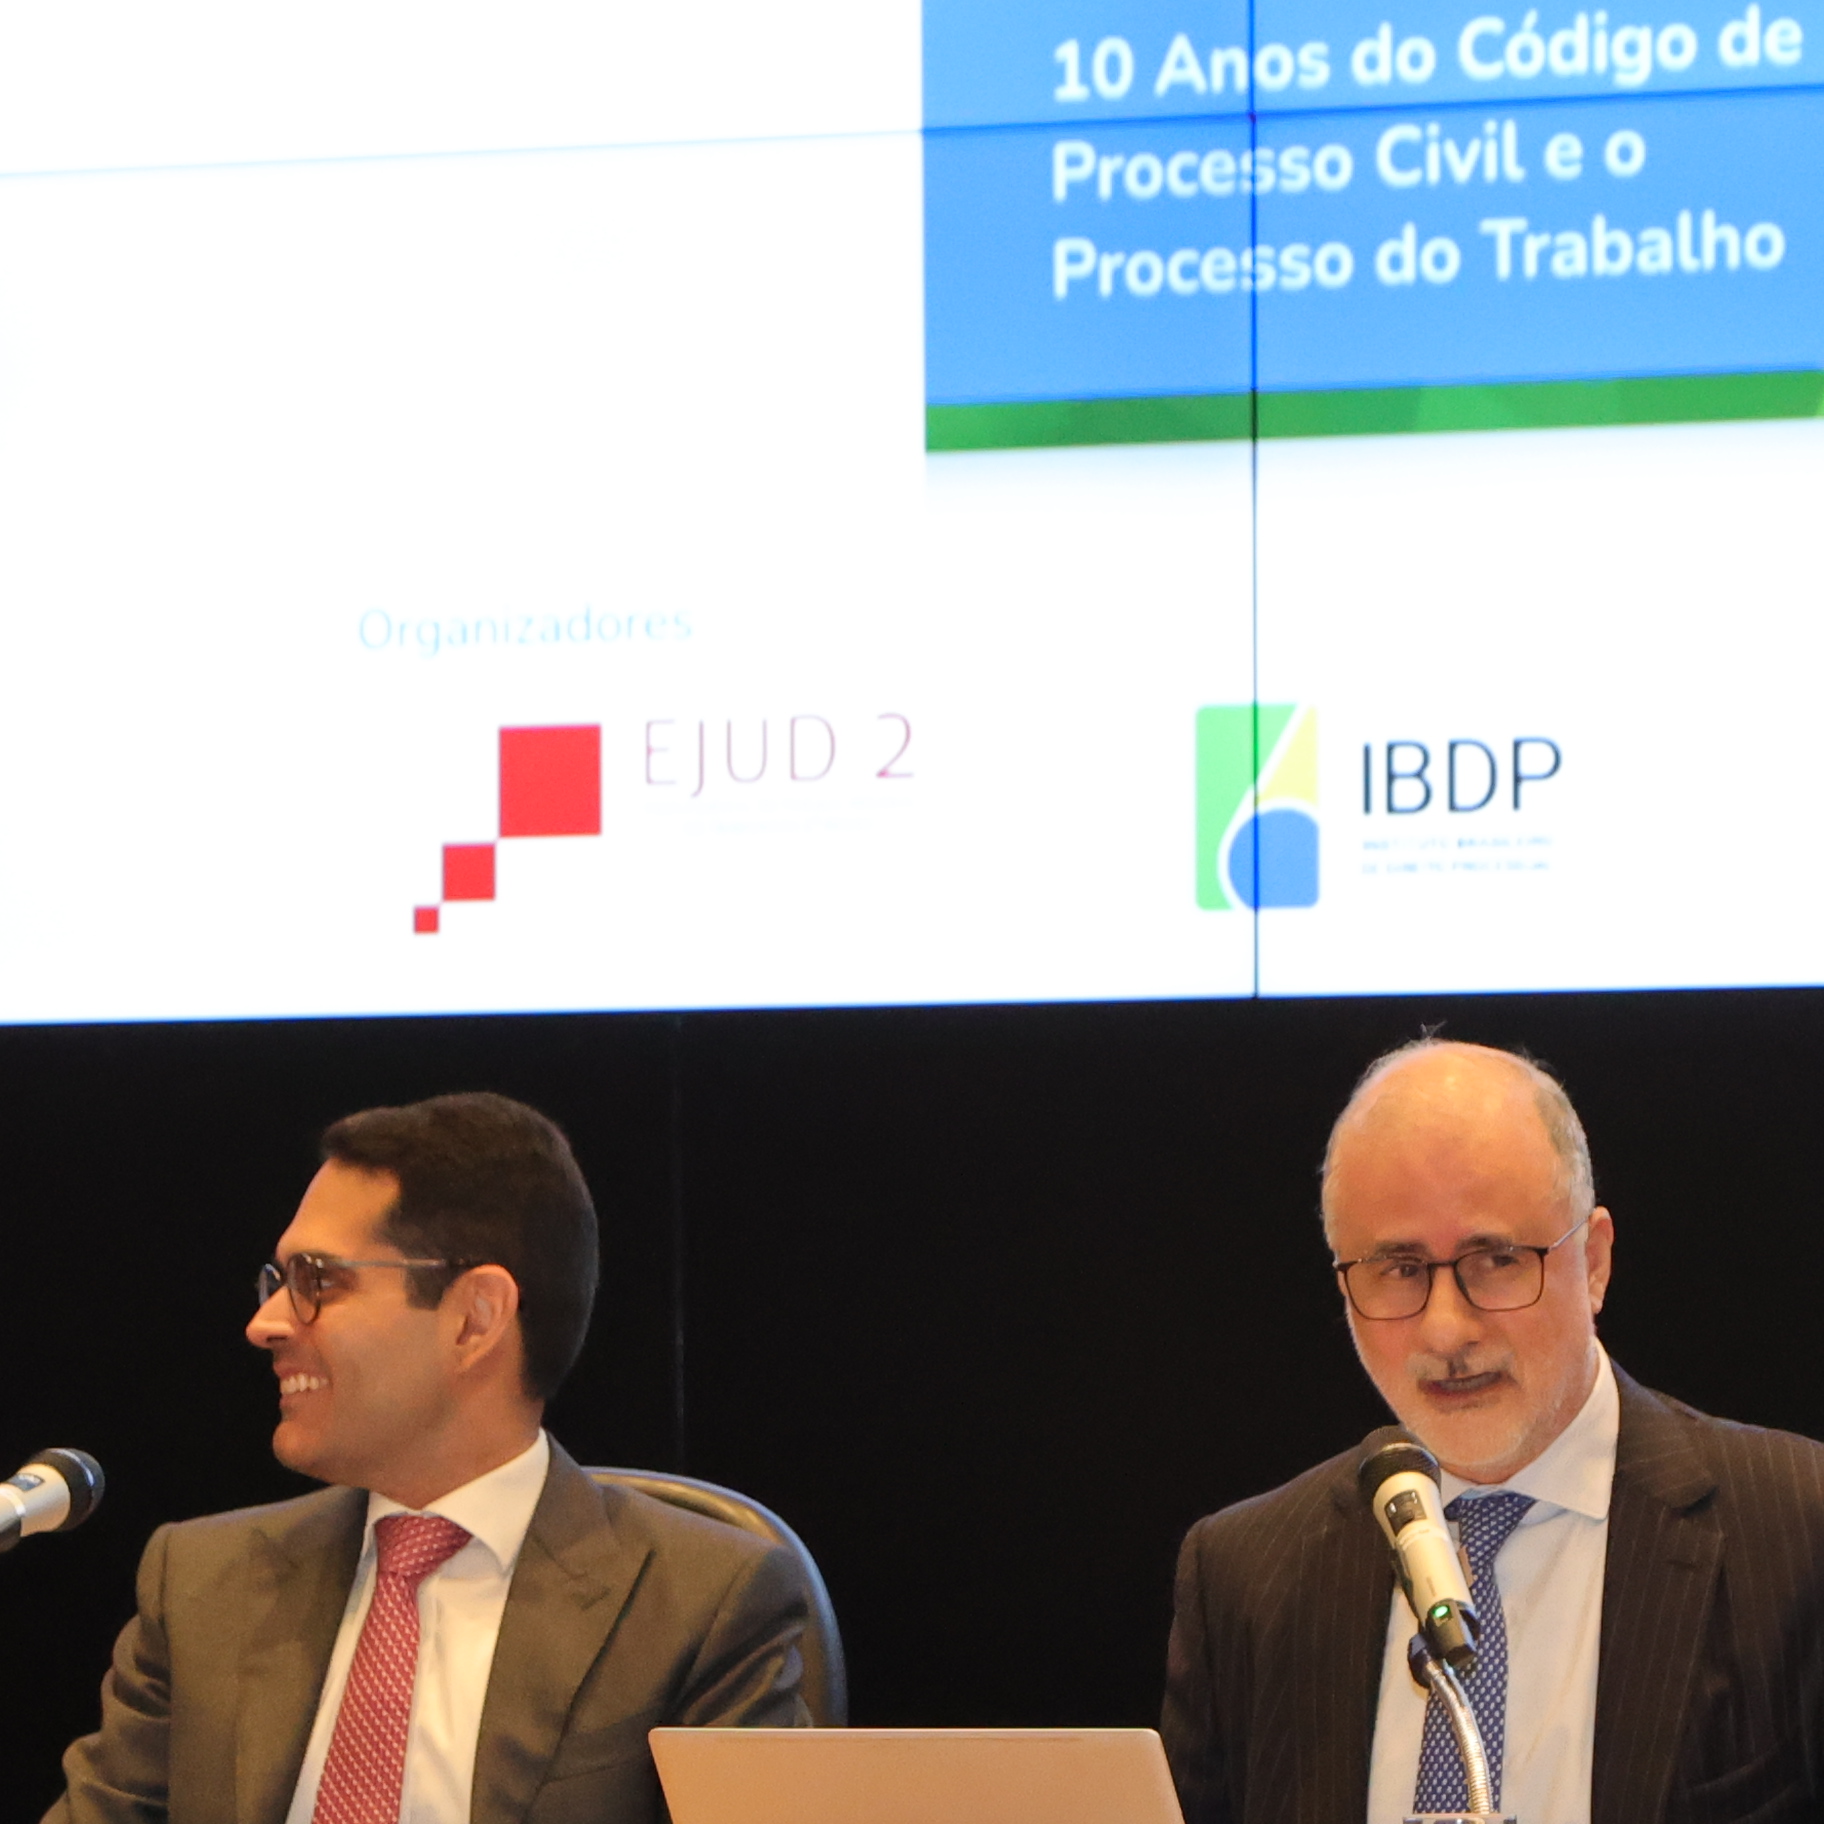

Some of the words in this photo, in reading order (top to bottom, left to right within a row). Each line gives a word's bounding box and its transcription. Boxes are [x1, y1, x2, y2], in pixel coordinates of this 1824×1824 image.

[1054, 37, 1134, 101] 10
[1154, 33, 1331, 97] Anos
[1350, 22, 1438, 87] do
[1457, 8, 1699, 88] Código
[1717, 3, 1804, 69] de
[1053, 143, 1354, 202] Processo
[1375, 119, 1526, 188] Civil
[1543, 132, 1584, 181] e
[1603, 129, 1647, 177] o
[1053, 240, 1355, 299] Processo
[1374, 222, 1462, 285] do
[1479, 208, 1786, 280] Trabalho
[358, 604, 694, 658] Organizadores
[644, 715, 837, 798] EJUD
[874, 711, 915, 780] 2
[1362, 737, 1564, 815] IBDP
